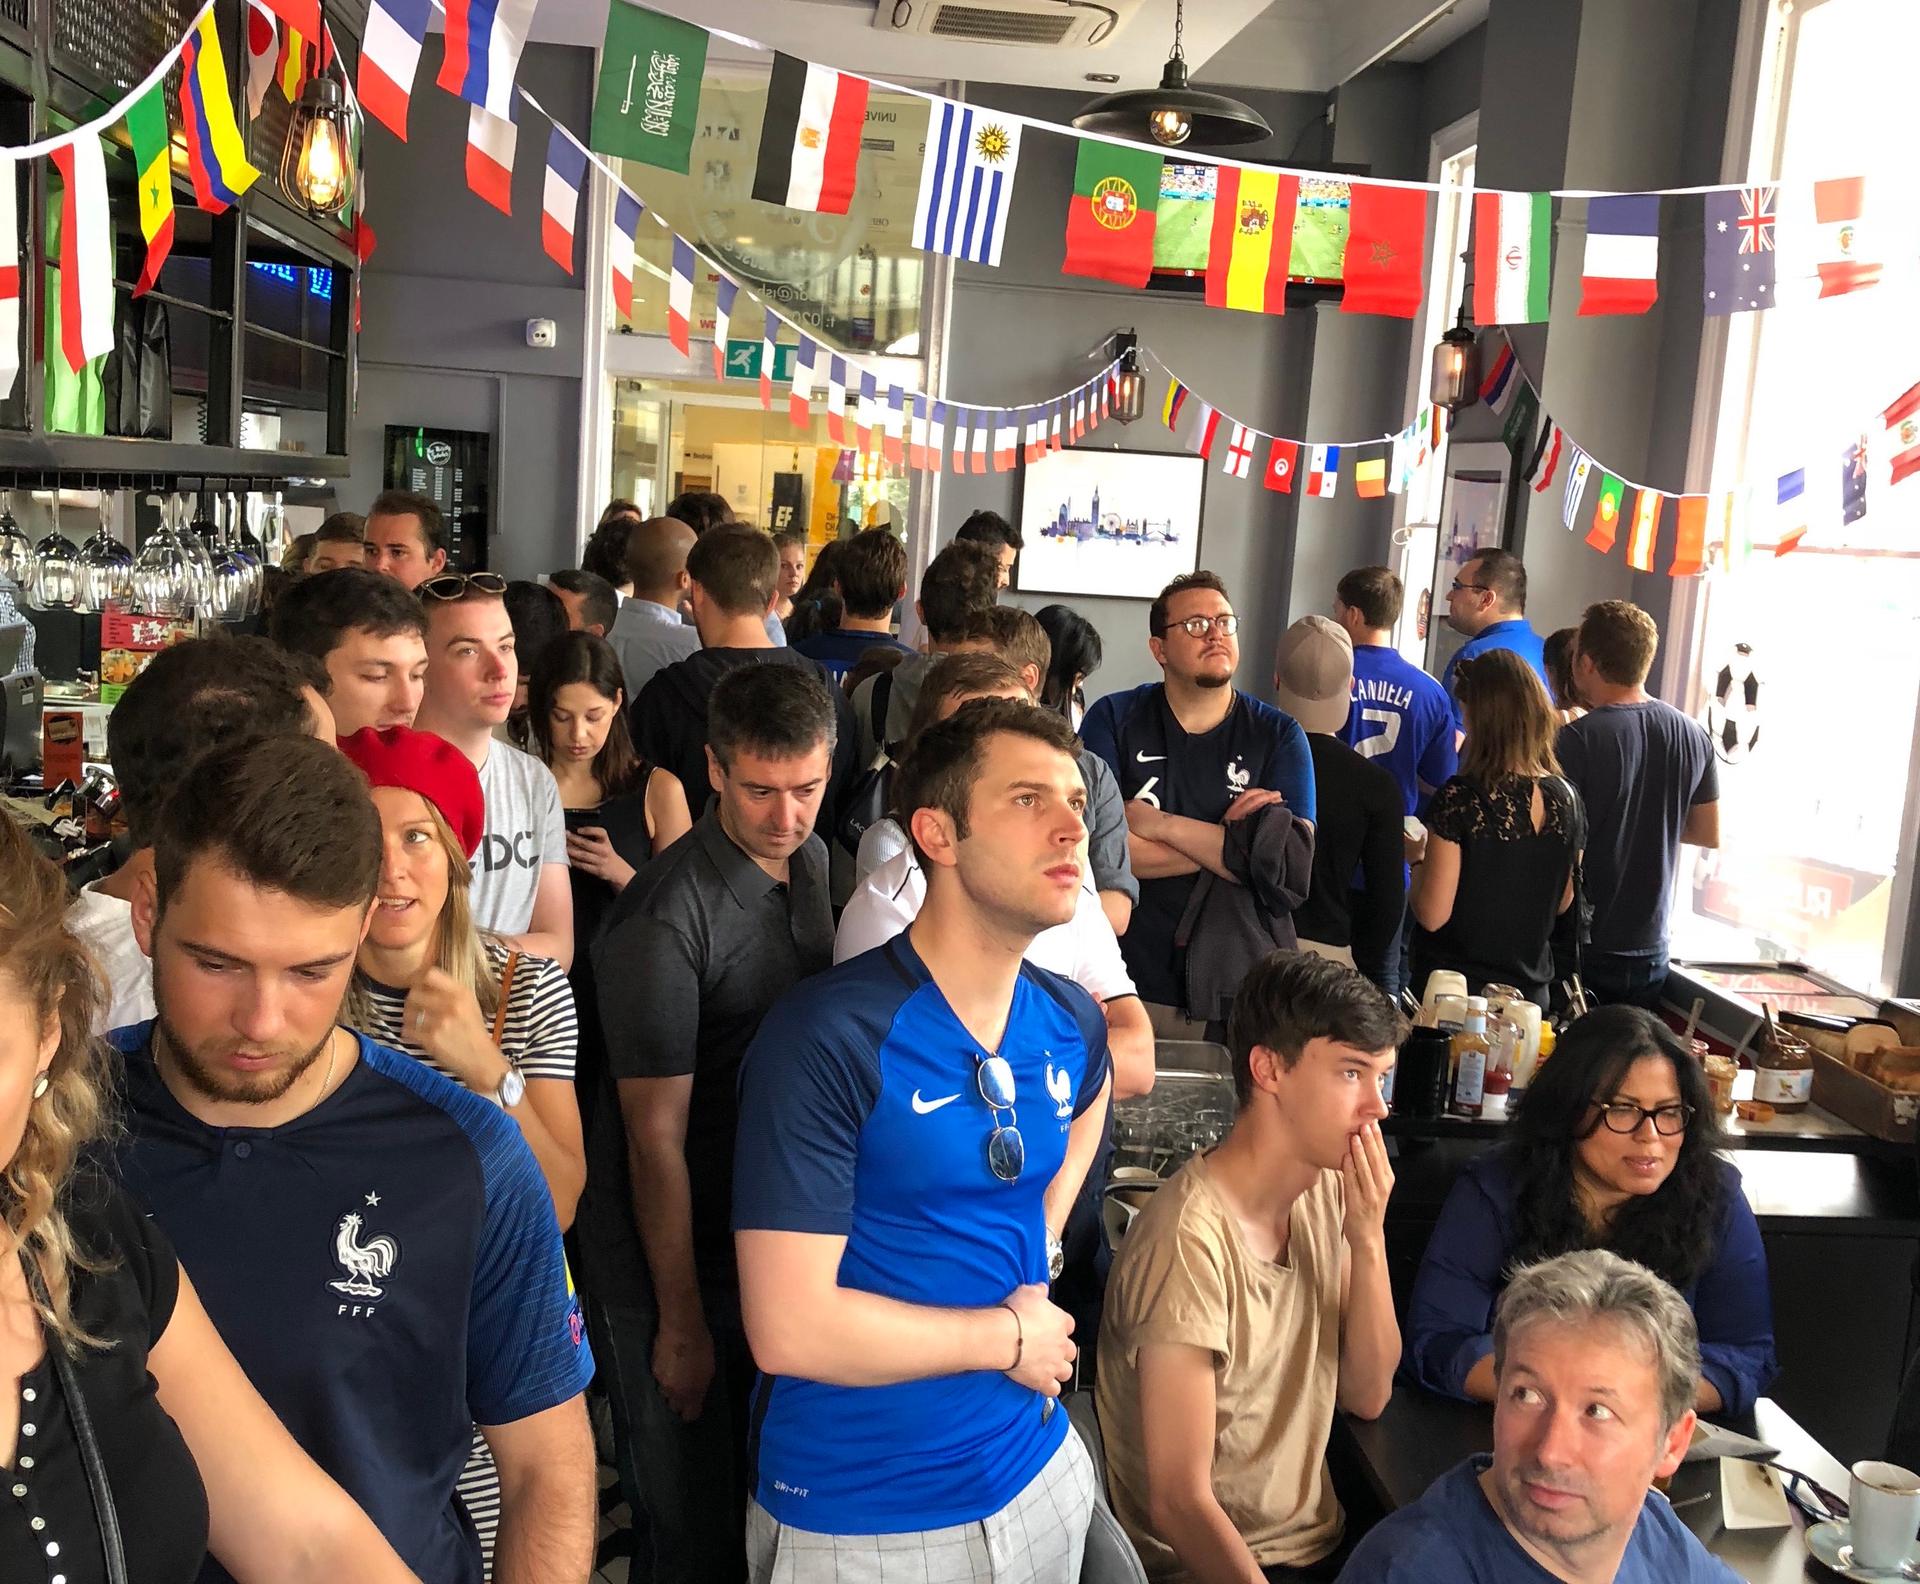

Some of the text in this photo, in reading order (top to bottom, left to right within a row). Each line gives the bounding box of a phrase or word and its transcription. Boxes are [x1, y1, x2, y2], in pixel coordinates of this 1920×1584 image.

[776, 505, 794, 528] EF
[468, 831, 540, 873] DC
[337, 1304, 375, 1318] FFF
[773, 1479, 810, 1498] DRI-FIT
